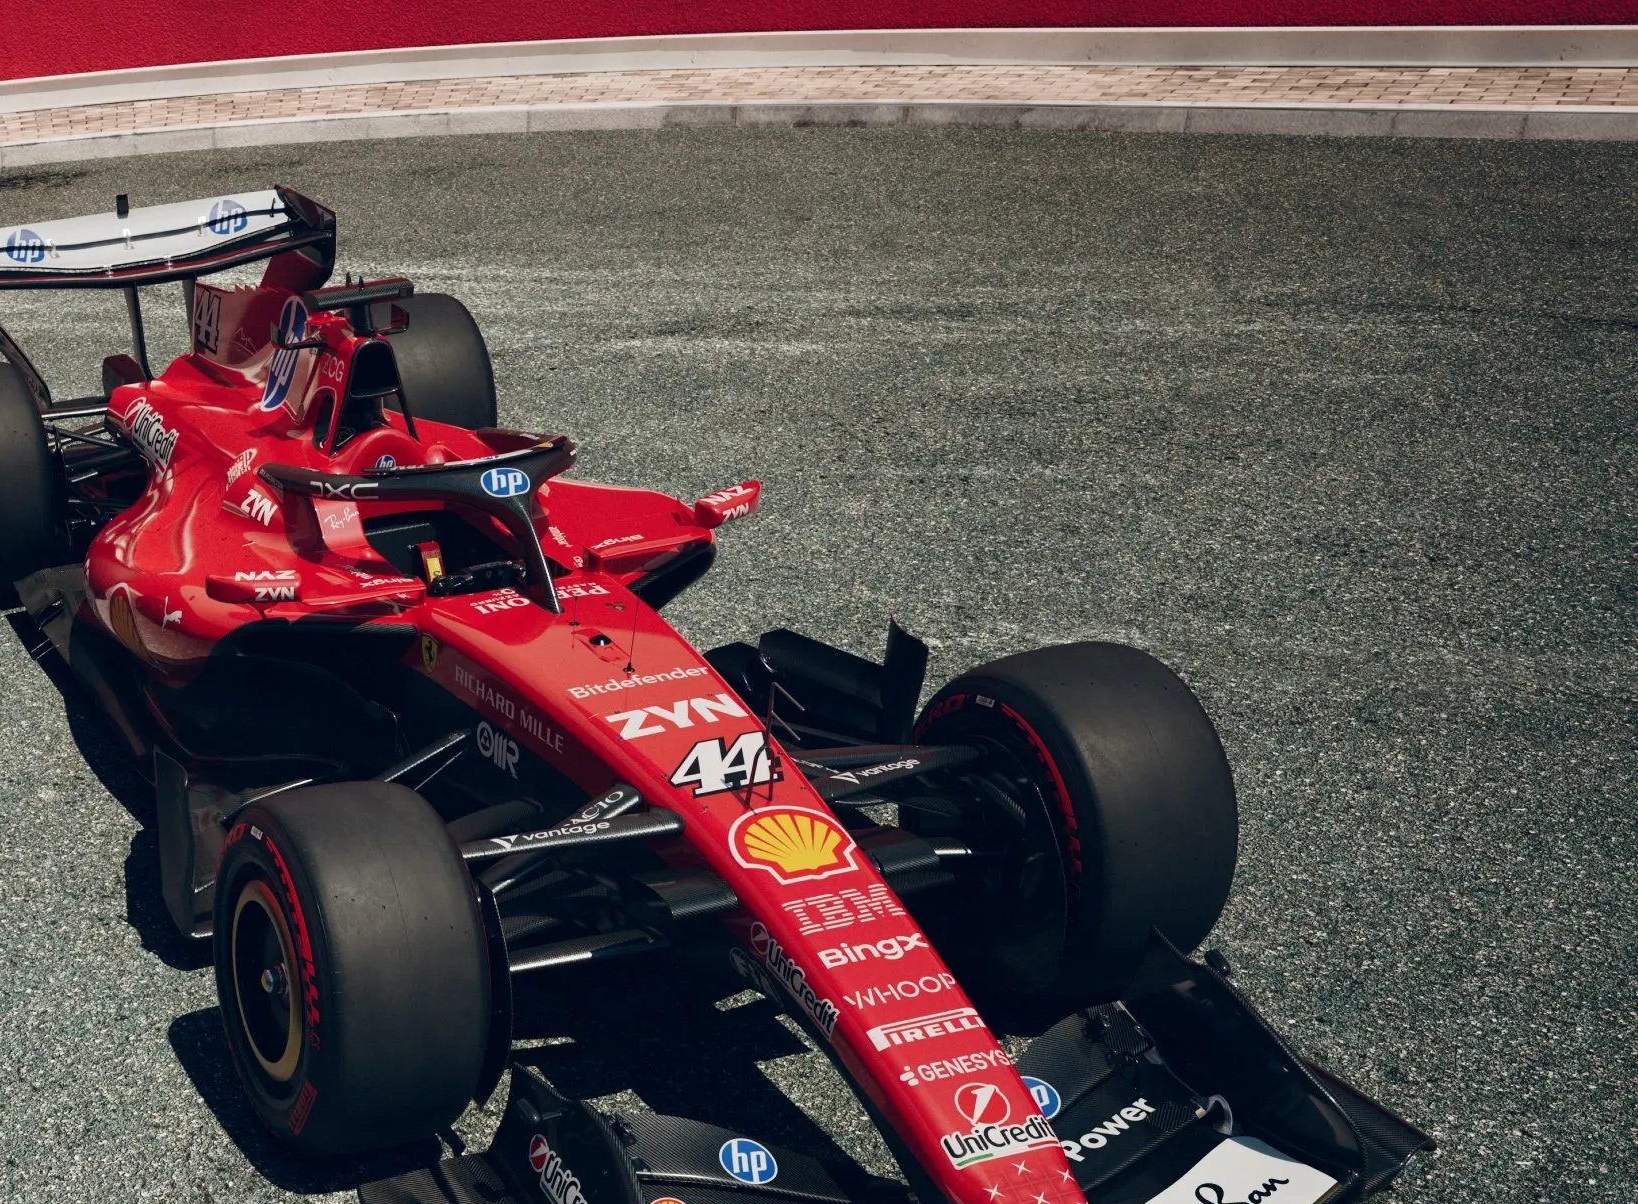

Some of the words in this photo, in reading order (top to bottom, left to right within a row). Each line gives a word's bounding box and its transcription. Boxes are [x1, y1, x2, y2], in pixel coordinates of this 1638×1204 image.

[196, 290, 221, 355] 44
[133, 405, 179, 466] UniCredit
[492, 468, 524, 496] hp
[241, 488, 278, 527] ZYN
[324, 505, 360, 531] Ray-Ban
[723, 503, 749, 521] ZYN
[255, 587, 294, 600] ZYN
[567, 666, 712, 699] Bitdefender
[454, 665, 515, 720] RICHARD
[520, 710, 563, 755] MILLE
[605, 693, 751, 741] ZYN
[669, 730, 784, 799] 44
[856, 759, 921, 777] vantage
[522, 822, 611, 841] vantage
[782, 883, 907, 936] IBM
[768, 938, 839, 1034] UniCredit
[843, 972, 956, 1010] WHOOP
[866, 1007, 987, 1052] PIRELLI
[919, 1049, 1011, 1082] GENESYS
[944, 1117, 1056, 1159] UniCredit
[1061, 1097, 1157, 1163] Power
[731, 1139, 766, 1184] hp
